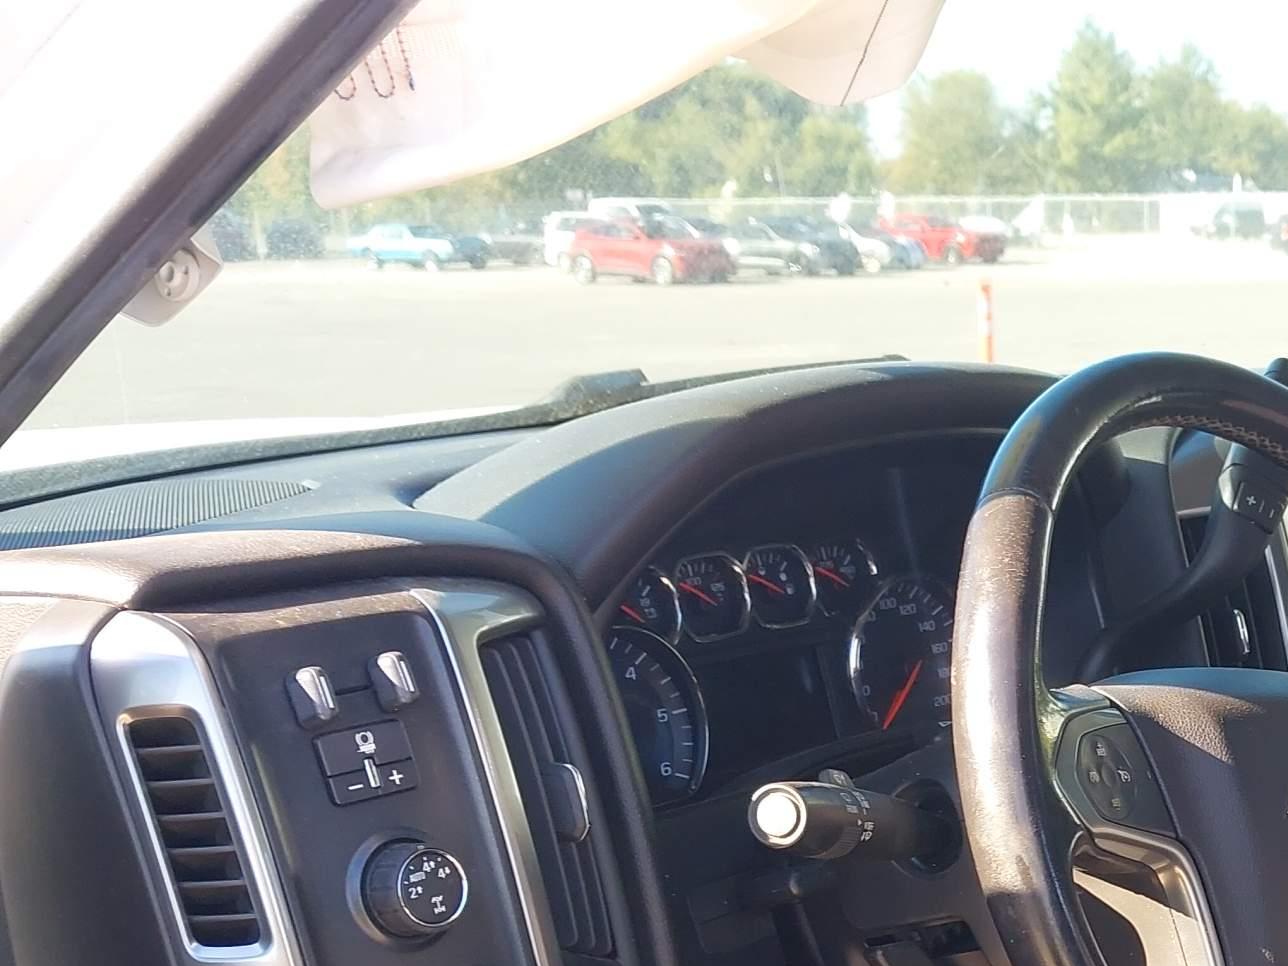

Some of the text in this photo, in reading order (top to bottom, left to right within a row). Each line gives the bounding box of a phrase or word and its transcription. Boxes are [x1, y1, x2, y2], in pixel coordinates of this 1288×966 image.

[899, 604, 917, 616] 120
[918, 620, 936, 633] 140
[625, 667, 637, 680] 4
[656, 708, 668, 722] 5
[660, 762, 672, 776] 6
